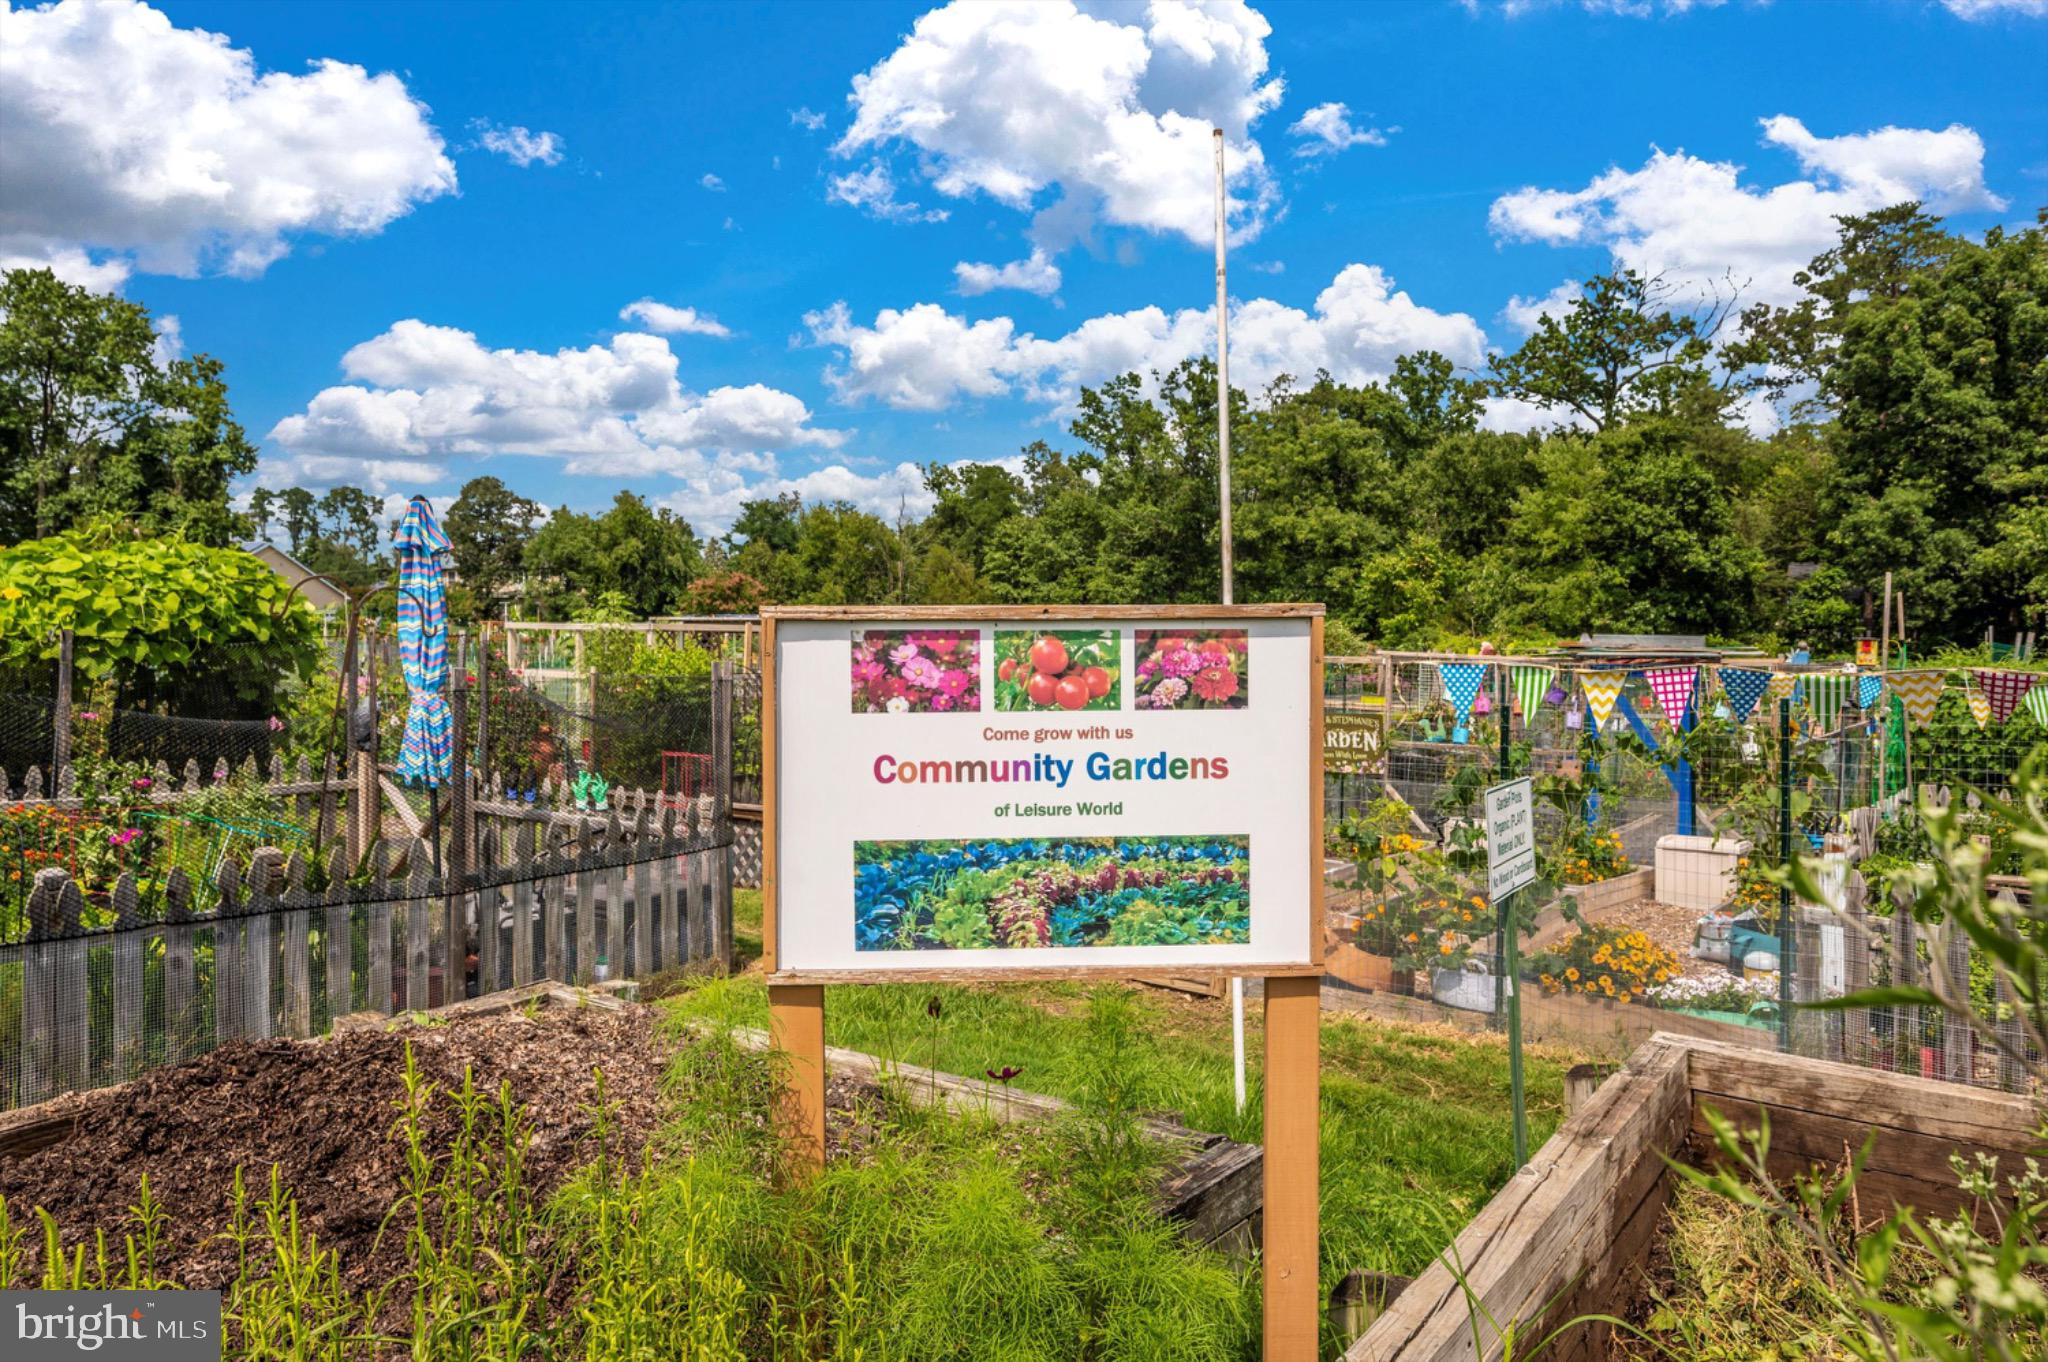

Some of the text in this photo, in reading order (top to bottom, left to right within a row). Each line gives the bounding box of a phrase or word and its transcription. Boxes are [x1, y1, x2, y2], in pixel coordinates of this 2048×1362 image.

[982, 725, 1134, 744] Come grow with us
[873, 750, 1230, 789] Community Gardens
[994, 801, 1123, 818] of Leisure World
